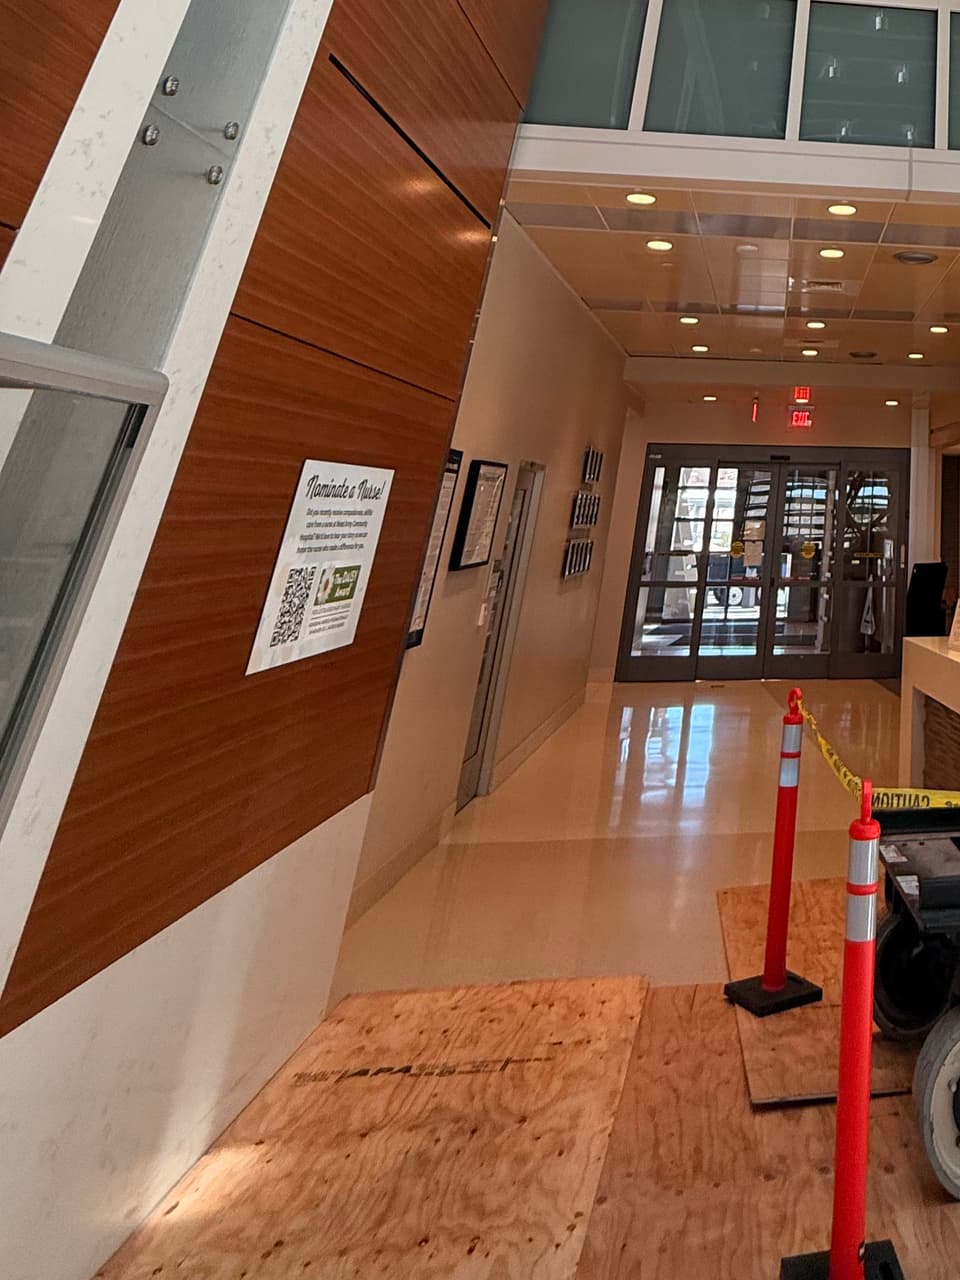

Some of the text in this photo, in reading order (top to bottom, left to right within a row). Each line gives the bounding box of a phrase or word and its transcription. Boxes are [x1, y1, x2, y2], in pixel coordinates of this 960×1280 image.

[306, 474, 387, 501] Nominate a Nurse!
